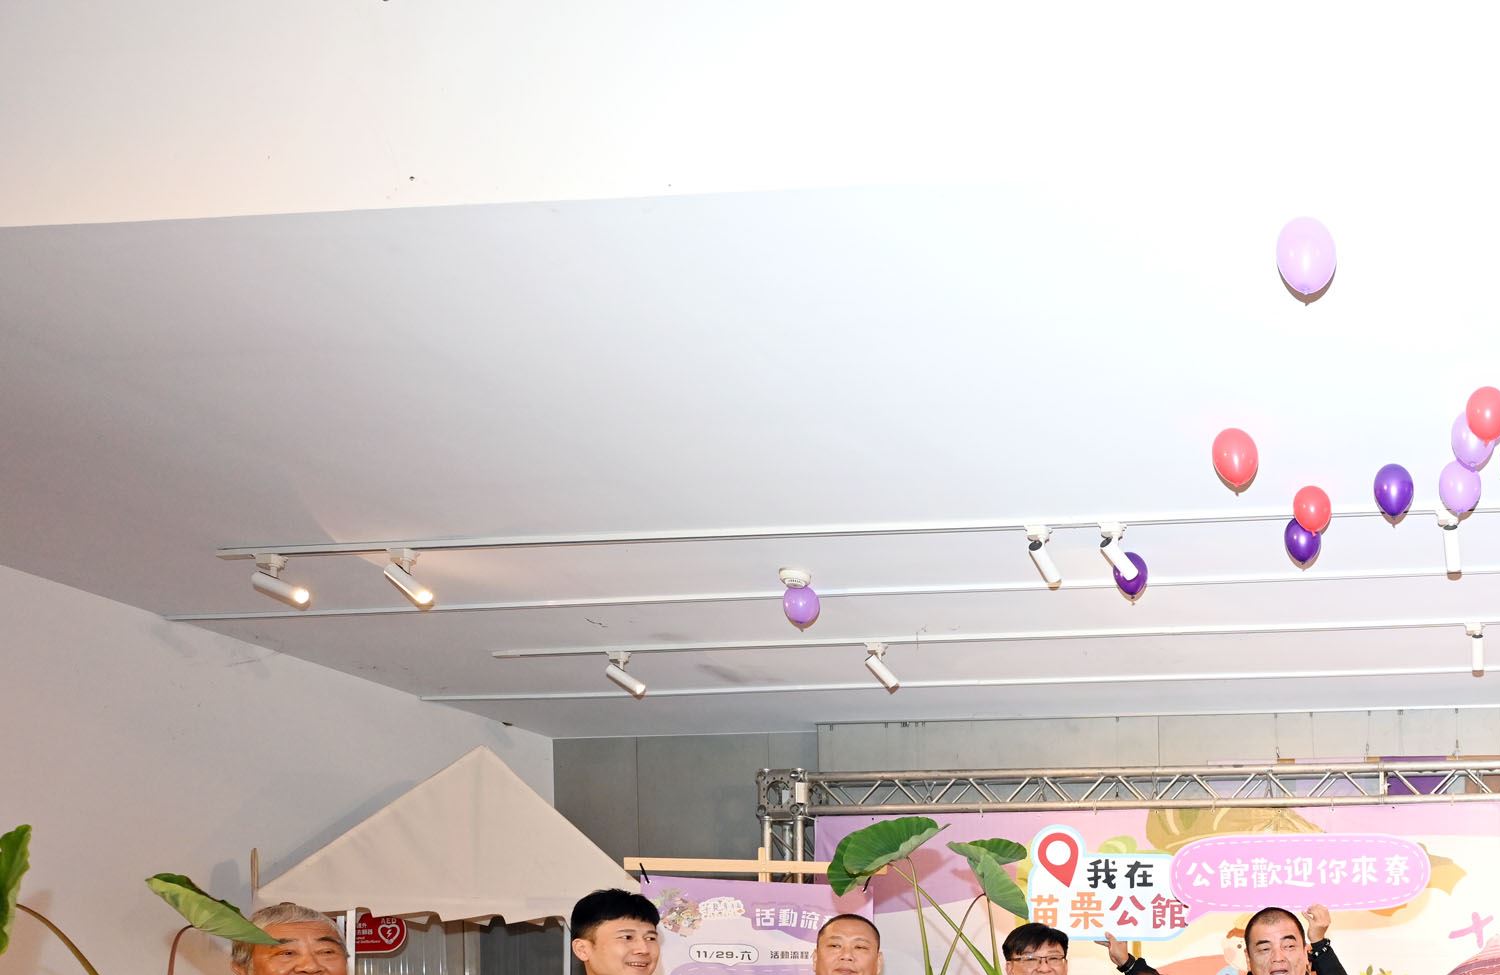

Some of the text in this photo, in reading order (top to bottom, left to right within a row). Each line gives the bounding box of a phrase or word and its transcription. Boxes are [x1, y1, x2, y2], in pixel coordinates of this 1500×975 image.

[1087, 858, 1154, 890] 我在
[755, 907, 834, 930] 活動流
[1029, 891, 1189, 930] 苗栗公館
